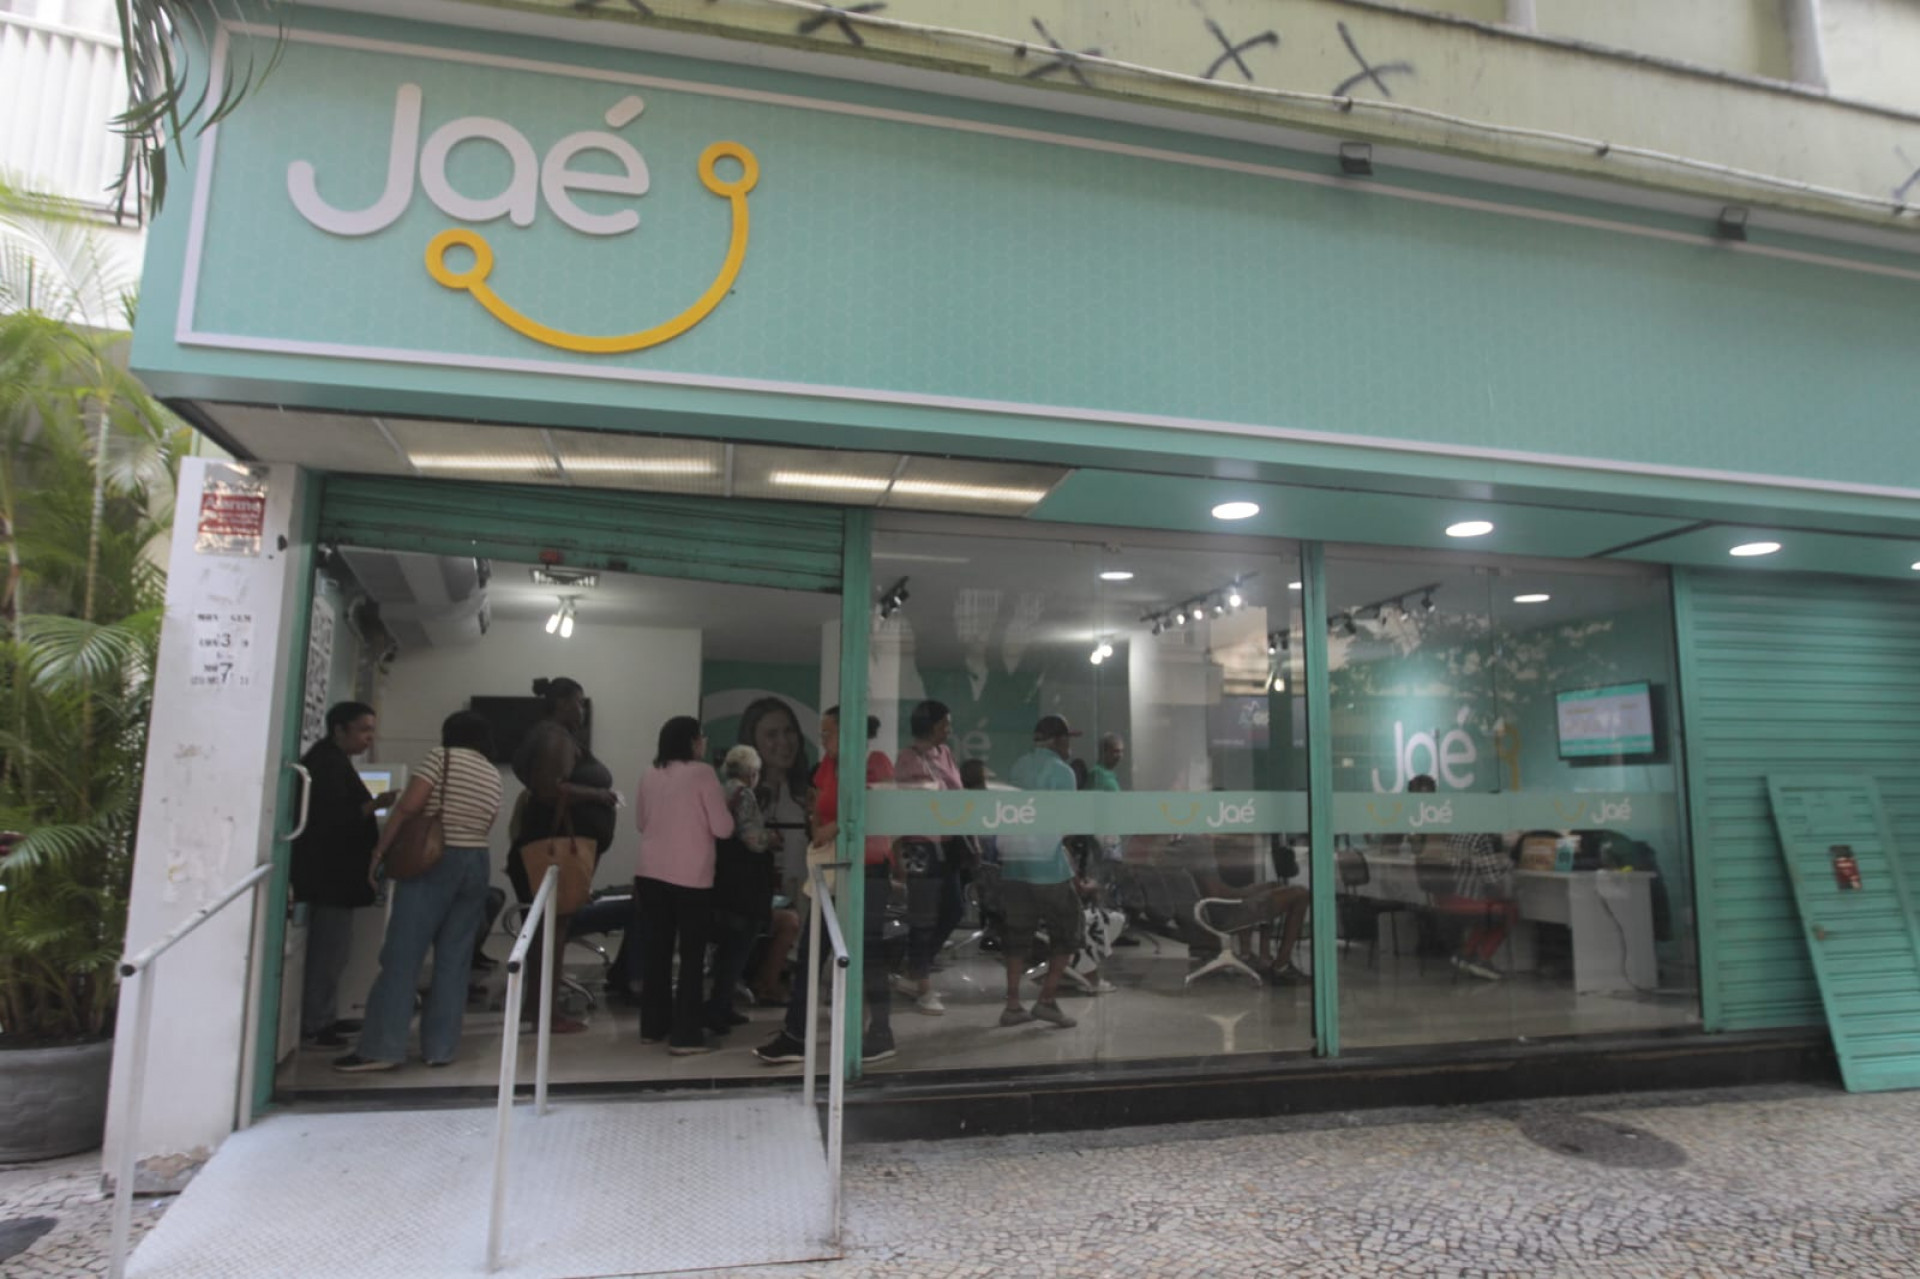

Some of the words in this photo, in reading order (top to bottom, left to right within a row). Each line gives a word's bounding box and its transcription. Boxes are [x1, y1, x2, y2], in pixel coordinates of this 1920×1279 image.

[287, 82, 650, 237] Jaé
[1371, 706, 1477, 794] Jaé
[982, 798, 1036, 829] Jaé
[1206, 798, 1256, 828] Jaé
[1409, 800, 1453, 827] Jaé
[1591, 798, 1632, 824] Jaé
